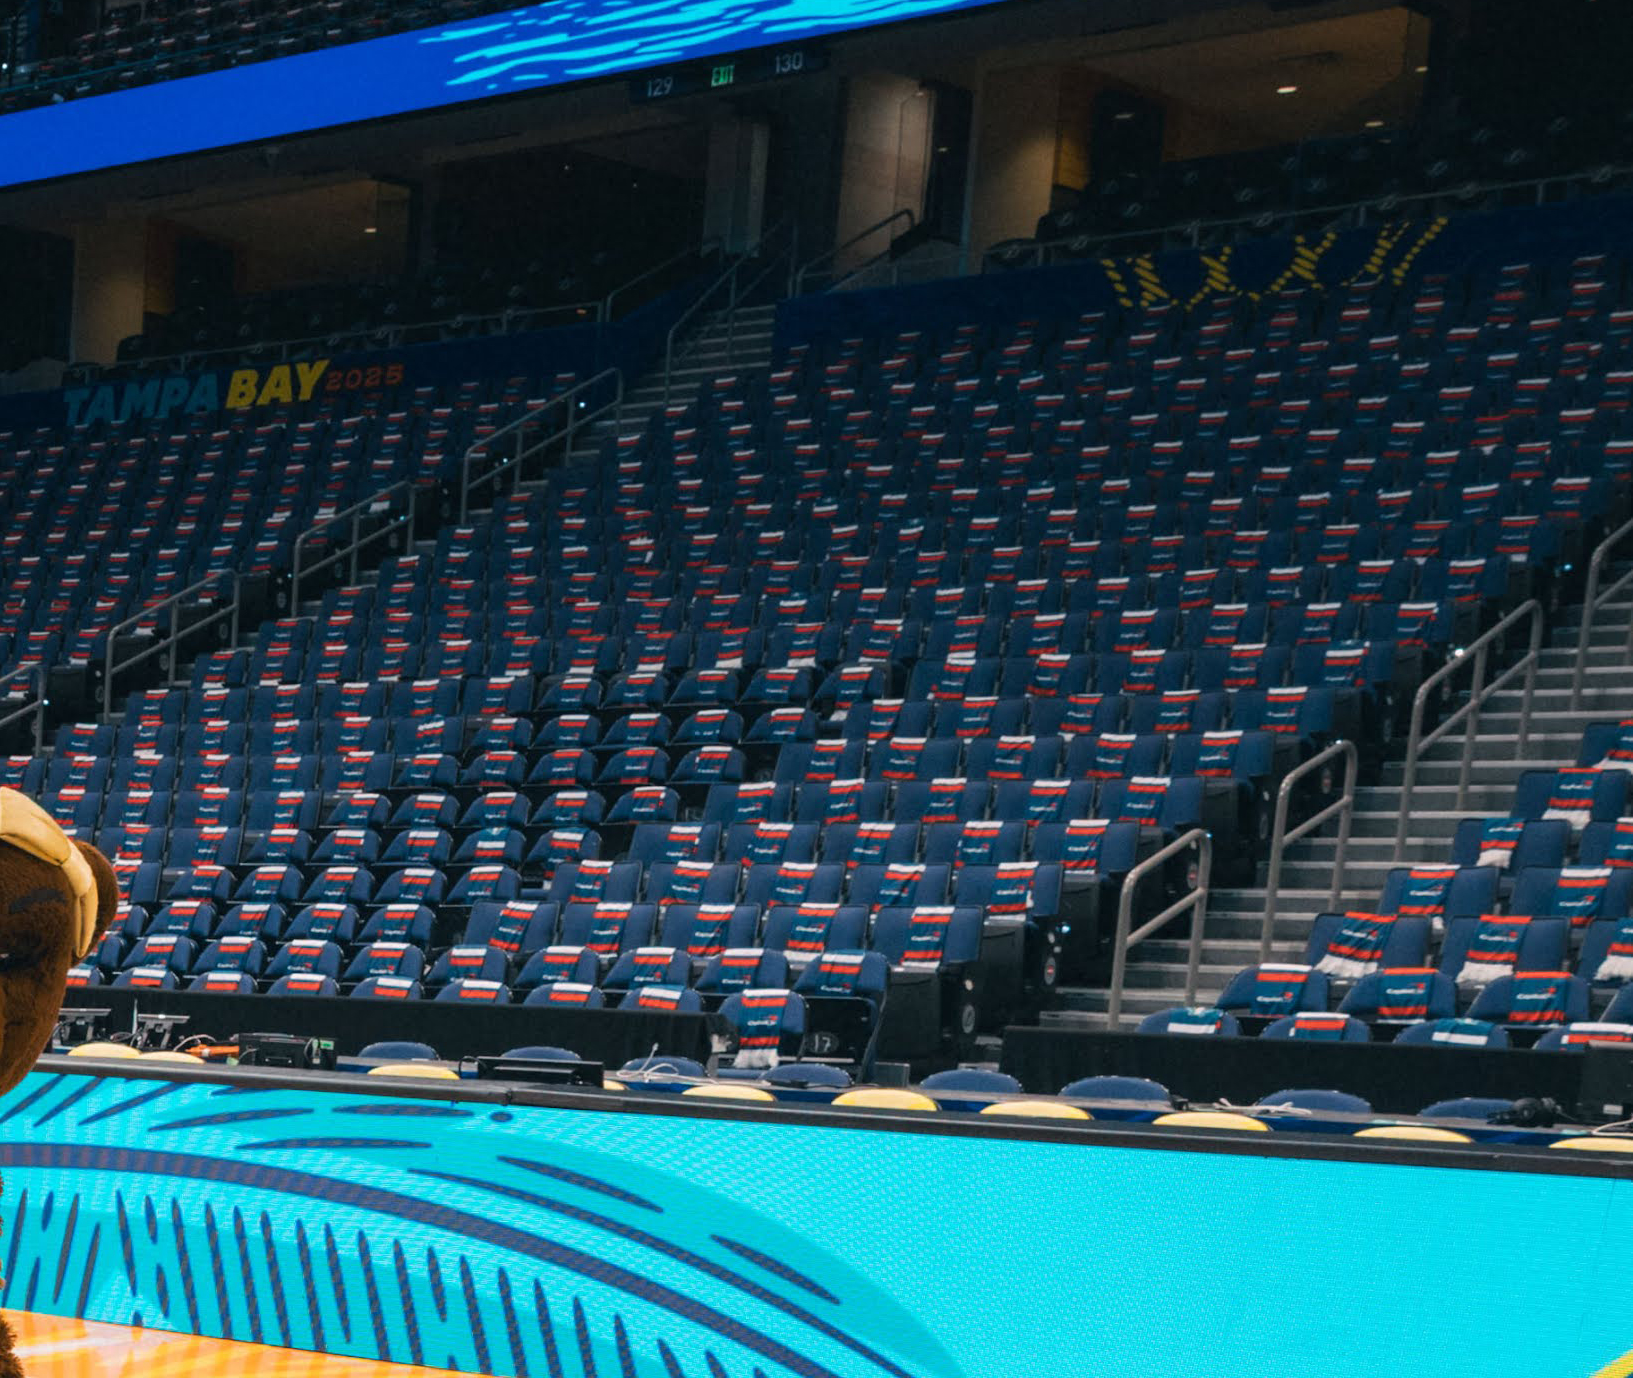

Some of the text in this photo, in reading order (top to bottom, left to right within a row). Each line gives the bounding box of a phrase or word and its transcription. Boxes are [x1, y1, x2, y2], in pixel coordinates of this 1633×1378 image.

[647, 52, 803, 97] 129 EXIT 130
[63, 360, 404, 425] TAMPA BAY 2025
